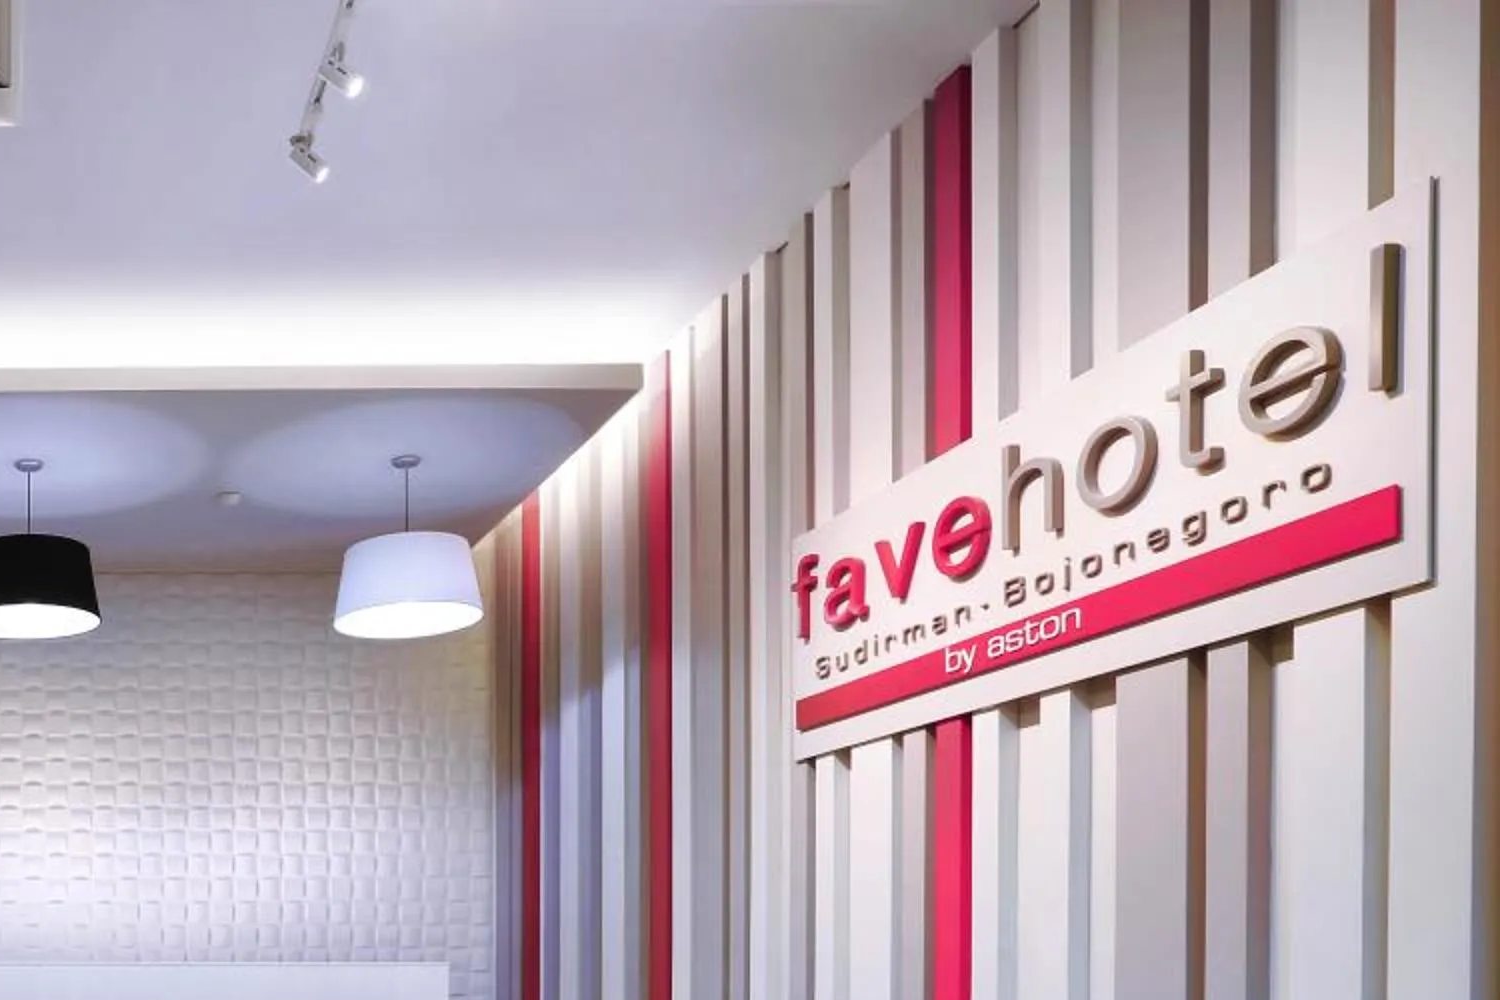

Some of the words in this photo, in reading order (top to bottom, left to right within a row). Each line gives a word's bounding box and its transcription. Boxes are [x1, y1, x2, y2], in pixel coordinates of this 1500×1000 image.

[791, 242, 1407, 645] favehotel
[814, 604, 972, 680] Sudirman
[944, 644, 976, 674] by
[987, 607, 1082, 659] aston
